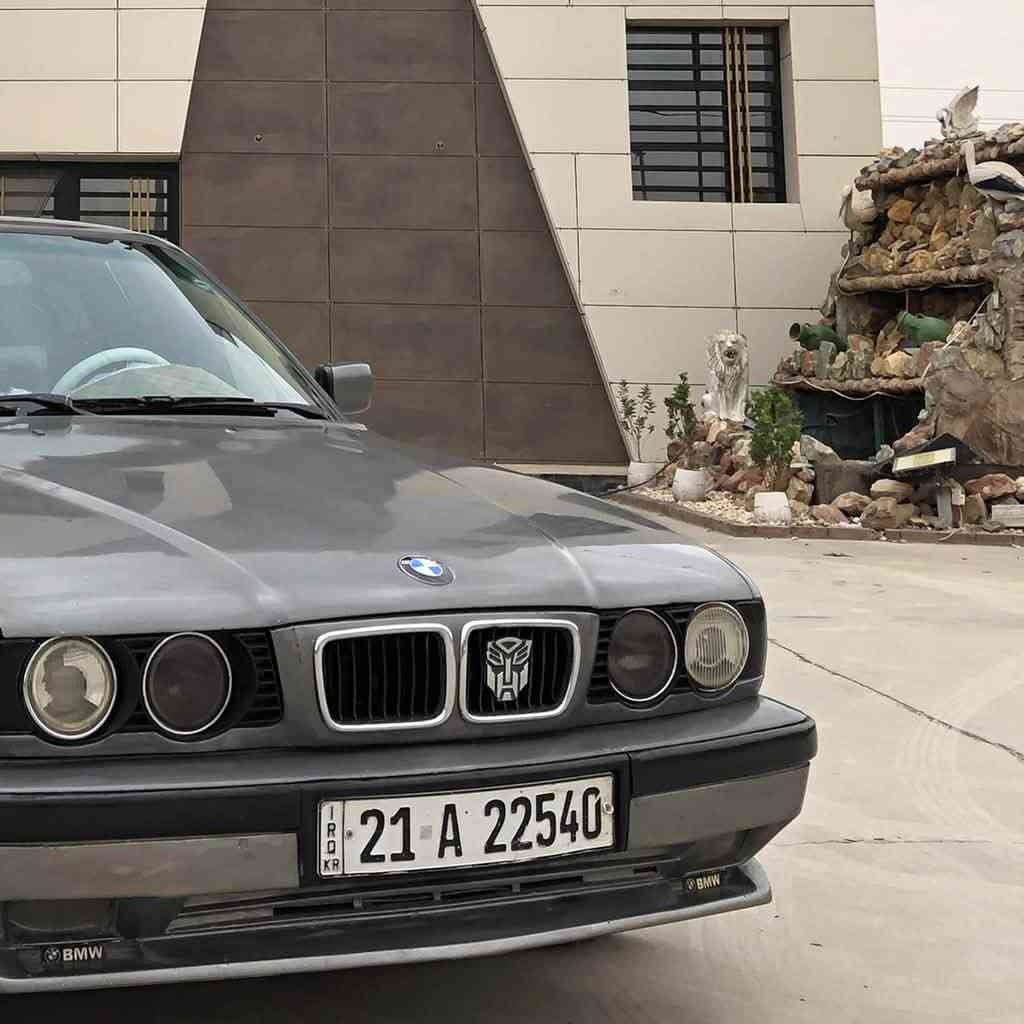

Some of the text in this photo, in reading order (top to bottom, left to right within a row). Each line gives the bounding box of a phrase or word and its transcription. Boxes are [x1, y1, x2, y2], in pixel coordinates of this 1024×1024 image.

[359, 786, 602, 865] 21 A 22540
[695, 874, 721, 890] BMW
[63, 945, 103, 961] BMW
